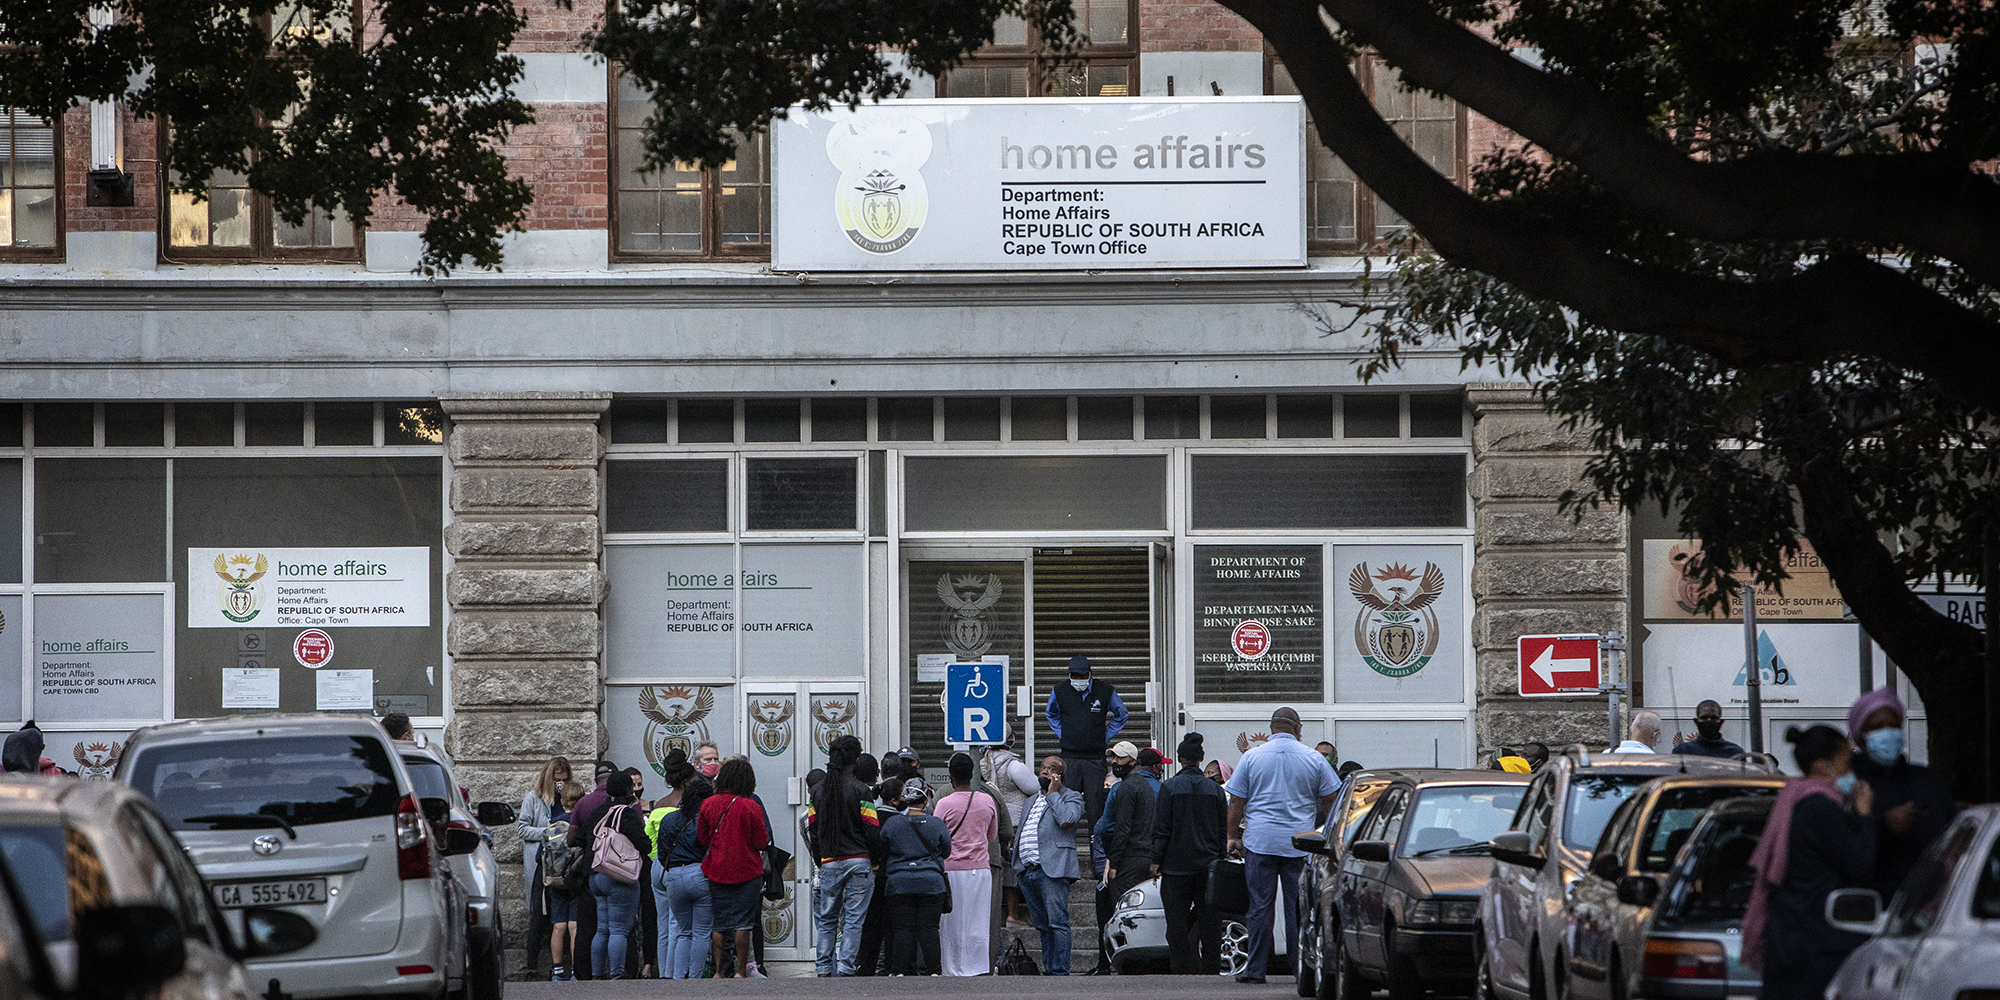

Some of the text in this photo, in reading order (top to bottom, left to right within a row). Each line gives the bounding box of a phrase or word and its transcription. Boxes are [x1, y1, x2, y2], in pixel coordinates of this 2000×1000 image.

[1000, 135, 1267, 170] home affairs
[1001, 188, 1105, 206] Department:
[1002, 206, 1111, 220] Home Affairs
[1001, 222, 1265, 238] REPUBLIC OF SOUTH AFRICA
[1003, 240, 1148, 257] Cape Town Office
[1210, 557, 1306, 567] DEPARTMENT OF
[278, 560, 387, 577] home affairs
[667, 570, 778, 587] home afairs
[1216, 569, 1301, 579] HOME AFFAIRS
[277, 587, 327, 596] Department:
[278, 596, 328, 604] Home Affairs
[1732, 598, 1844, 606] REBLIC OF SOUTH AFR
[278, 605, 405, 615] REPUBLIC OF SOUTH AFRICA
[667, 600, 731, 611] Department:
[1204, 605, 1314, 615] DEPARTEMENT VAN
[667, 611, 735, 621] Home Affairs
[1759, 608, 1781, 617] Cape
[1782, 608, 1803, 616] Town
[277, 616, 349, 626] Office: Cape Town
[1285, 617, 1316, 626] SAKE
[667, 624, 719, 632] REPUBLIC
[721, 623, 734, 632] OF
[775, 623, 814, 632] AFRICA
[42, 639, 129, 652] home affairs
[1202, 653, 1234, 662] ISEBE
[42, 662, 92, 671] Department:
[42, 670, 95, 678] Home Affairs
[42, 679, 84, 687] REPUBLIC
[97, 678, 125, 686] SOUTH
[126, 678, 157, 686] AFRICA
[963, 707, 991, 741] R
[930, 773, 950, 782] hom
[221, 883, 316, 905] CA 555-492
